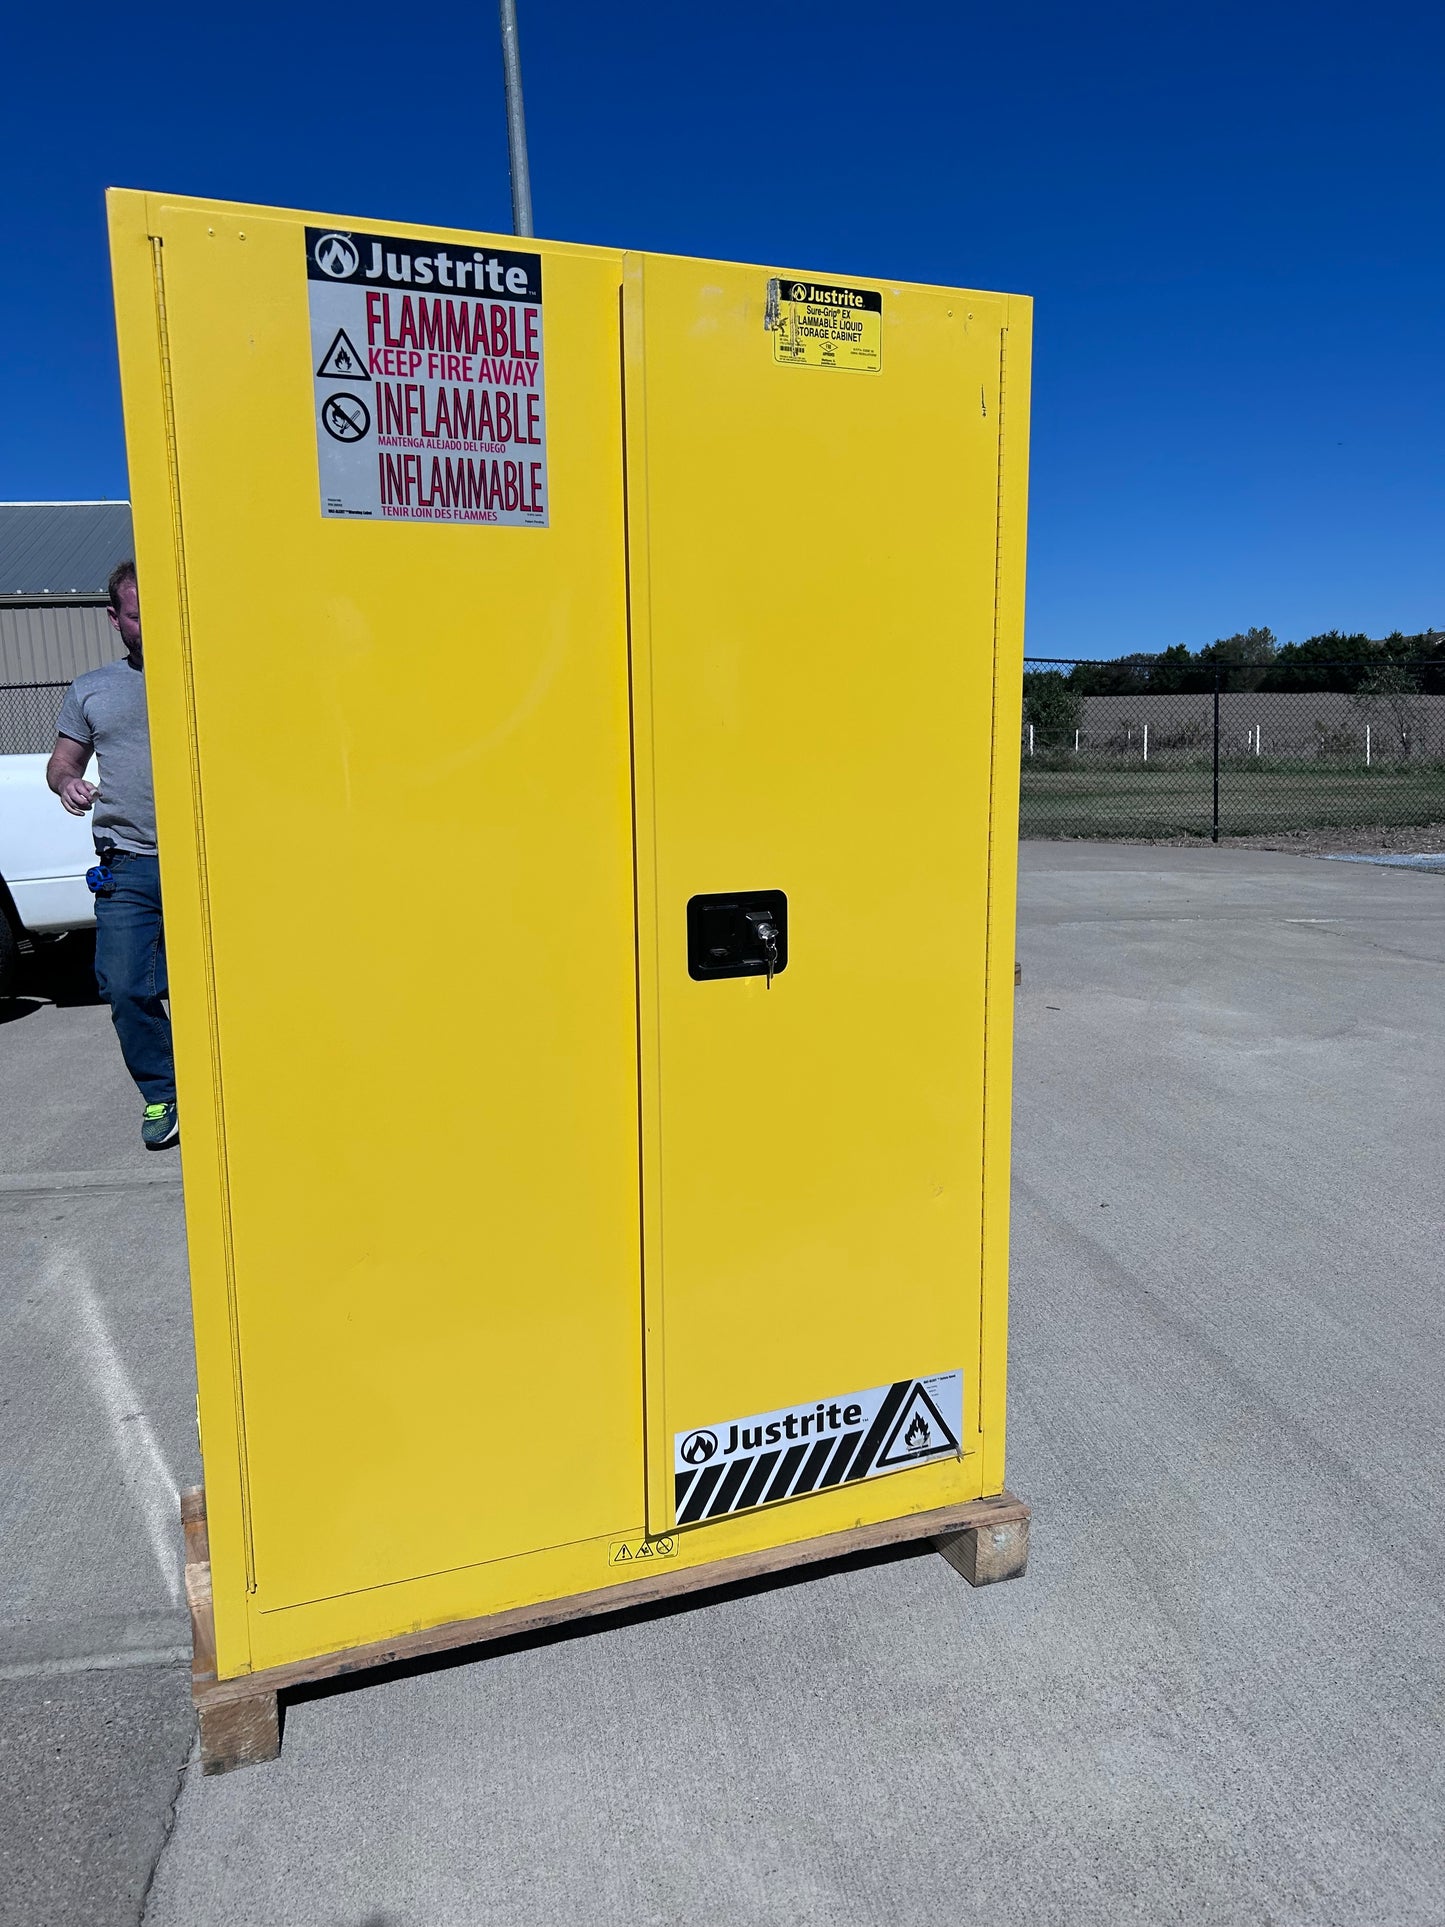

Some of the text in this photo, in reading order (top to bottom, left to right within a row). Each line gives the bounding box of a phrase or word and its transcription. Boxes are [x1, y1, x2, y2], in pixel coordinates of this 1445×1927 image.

[365, 242, 529, 295] Justrite
[808, 286, 863, 307] Justrite
[366, 291, 539, 360] FLAMMABLE
[797, 315, 863, 331] LAMMABLE LIQUID
[842, 309, 851, 319] EX
[831, 330, 861, 342] CABINET
[368, 347, 538, 388] KEEP FIRE AWAY
[375, 381, 541, 445] INFLAMABLE
[378, 435, 506, 454] MANTENGA ALEJADO DEL FUEGO
[379, 452, 543, 513] INFLAMMABLE
[381, 505, 409, 518] TENIR
[411, 507, 433, 519] LOIN
[434, 508, 452, 519] DES
[453, 510, 498, 521] FLAMMES
[723, 1403, 862, 1455] Justrite
